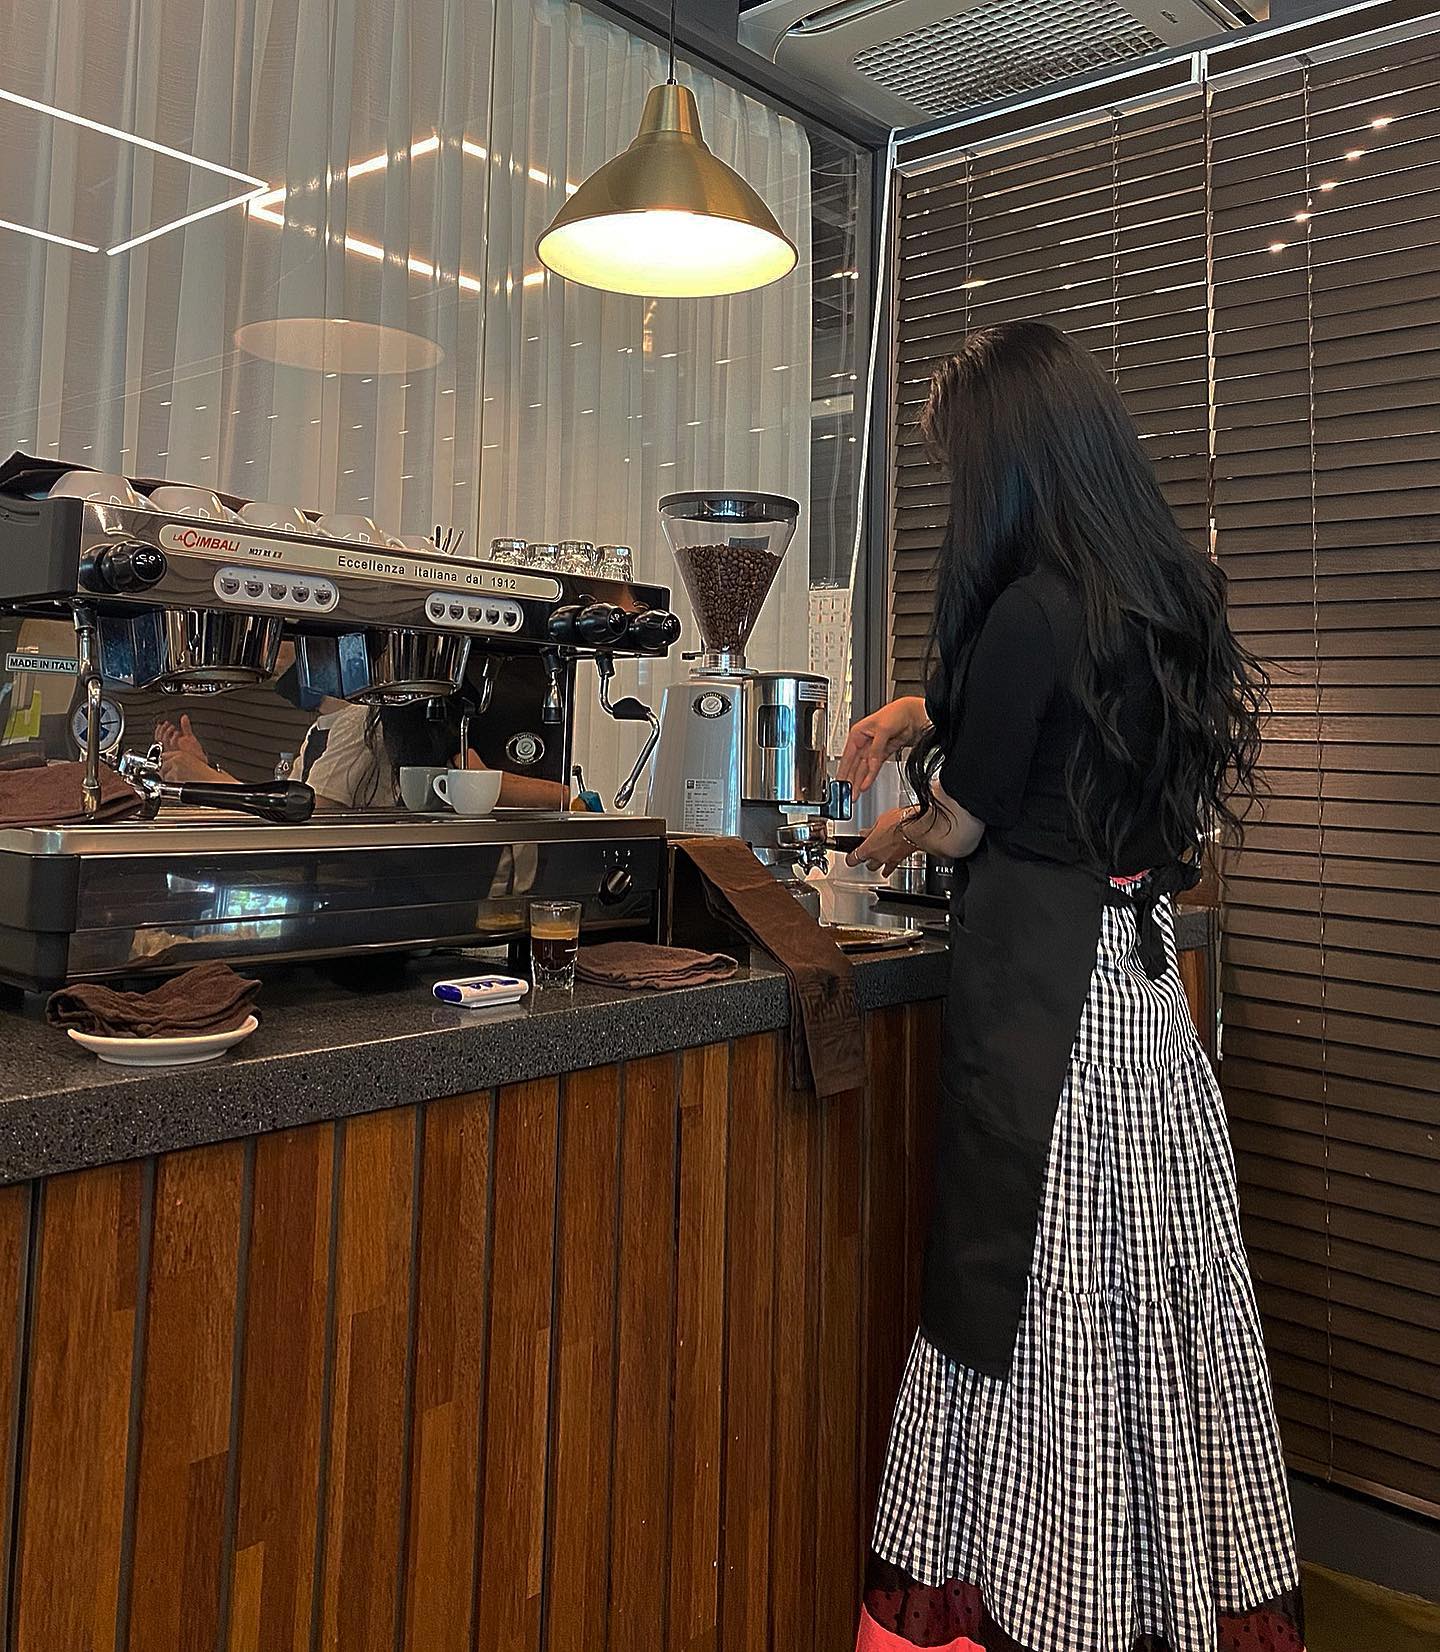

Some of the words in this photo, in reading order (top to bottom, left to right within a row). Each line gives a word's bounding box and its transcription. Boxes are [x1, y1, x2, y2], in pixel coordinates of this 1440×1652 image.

[338, 556, 405, 575] Eccellenza
[414, 566, 457, 582] italiana
[466, 573, 482, 585] dal
[491, 577, 516, 590] 1912
[10, 658, 37, 668] MADE
[40, 660, 49, 669] IN
[51, 661, 76, 671] ITALY
